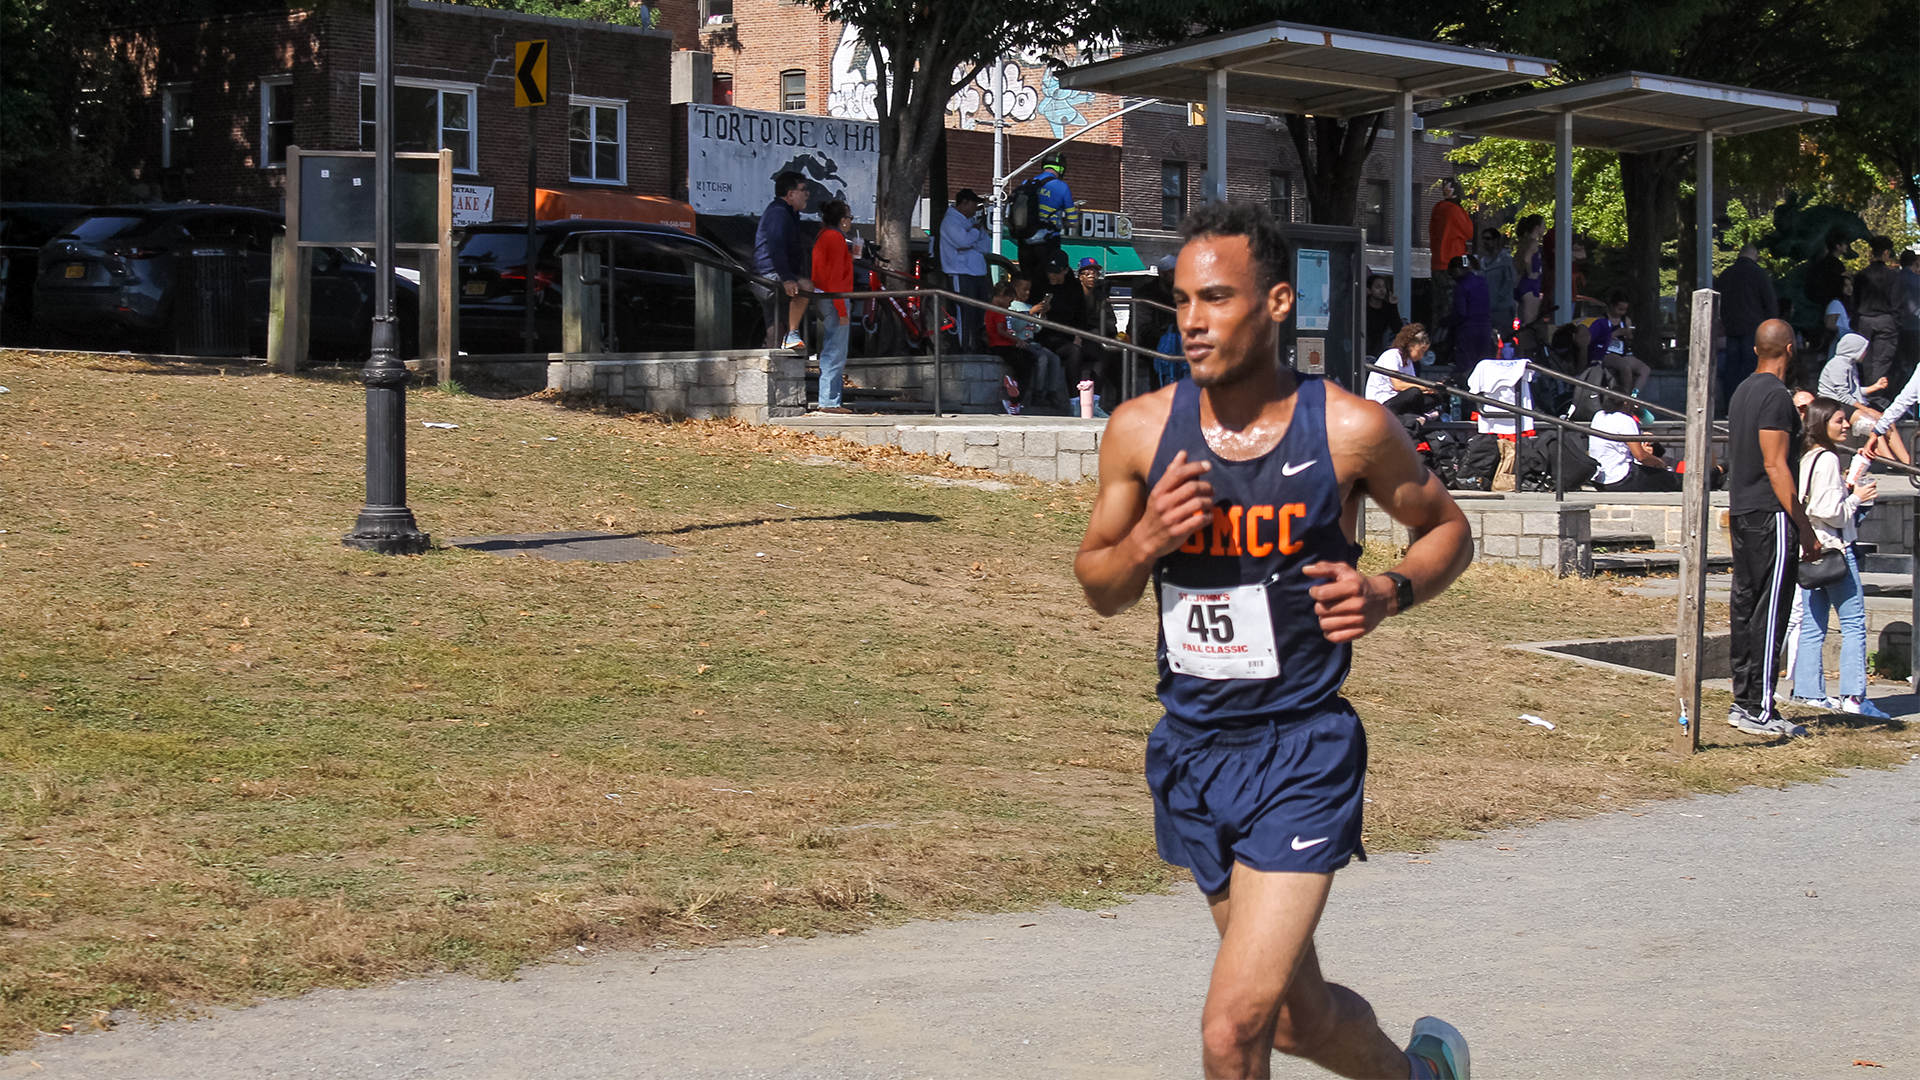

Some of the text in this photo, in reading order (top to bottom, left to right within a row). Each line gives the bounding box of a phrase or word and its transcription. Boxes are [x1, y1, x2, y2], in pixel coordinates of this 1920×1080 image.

[698, 109, 880, 153] TORTOISE & HA
[696, 181, 732, 193] KITCHEN
[1082, 212, 1118, 239] DELI
[1178, 592, 1230, 603] ST. JOHN'S
[1186, 603, 1235, 644] 45
[1182, 643, 1249, 654] FALL CLASSIC
